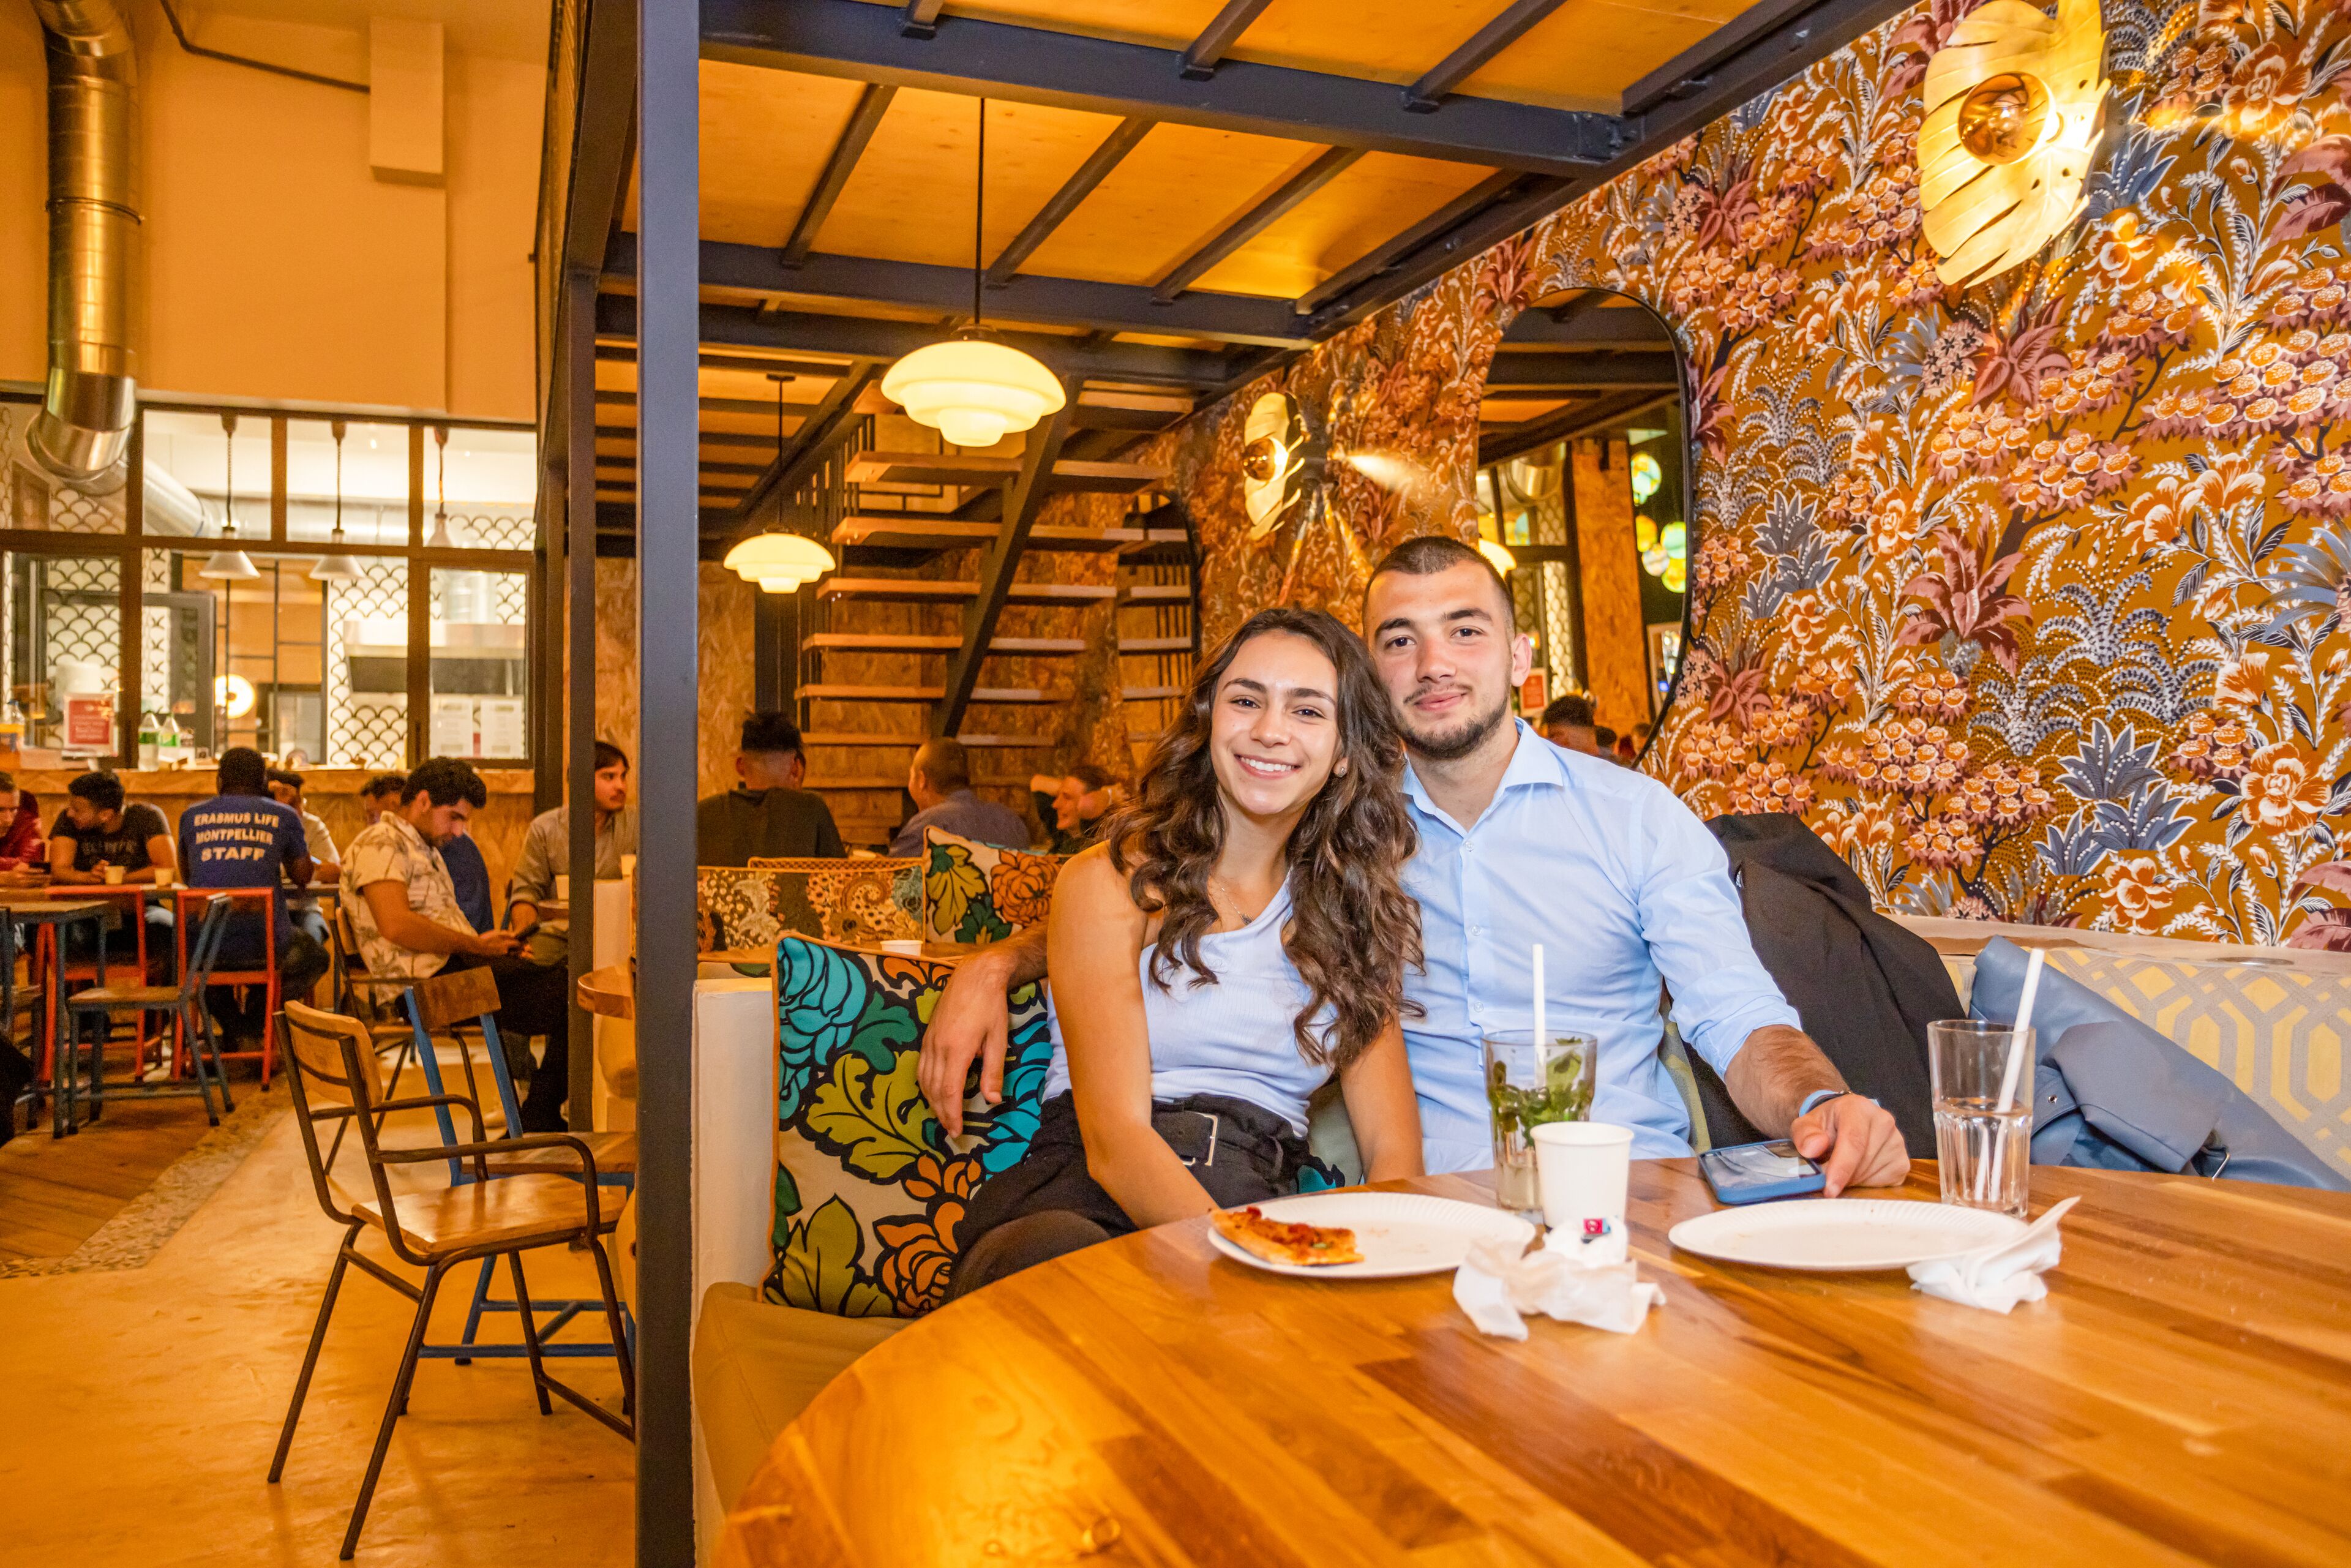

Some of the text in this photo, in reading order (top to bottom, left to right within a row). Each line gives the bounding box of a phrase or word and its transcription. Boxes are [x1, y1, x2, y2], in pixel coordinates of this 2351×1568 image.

[194, 812, 279, 828] ERASMUS LIFE
[196, 828, 273, 845] MONTPELLIER
[201, 847, 265, 862] STAFF
